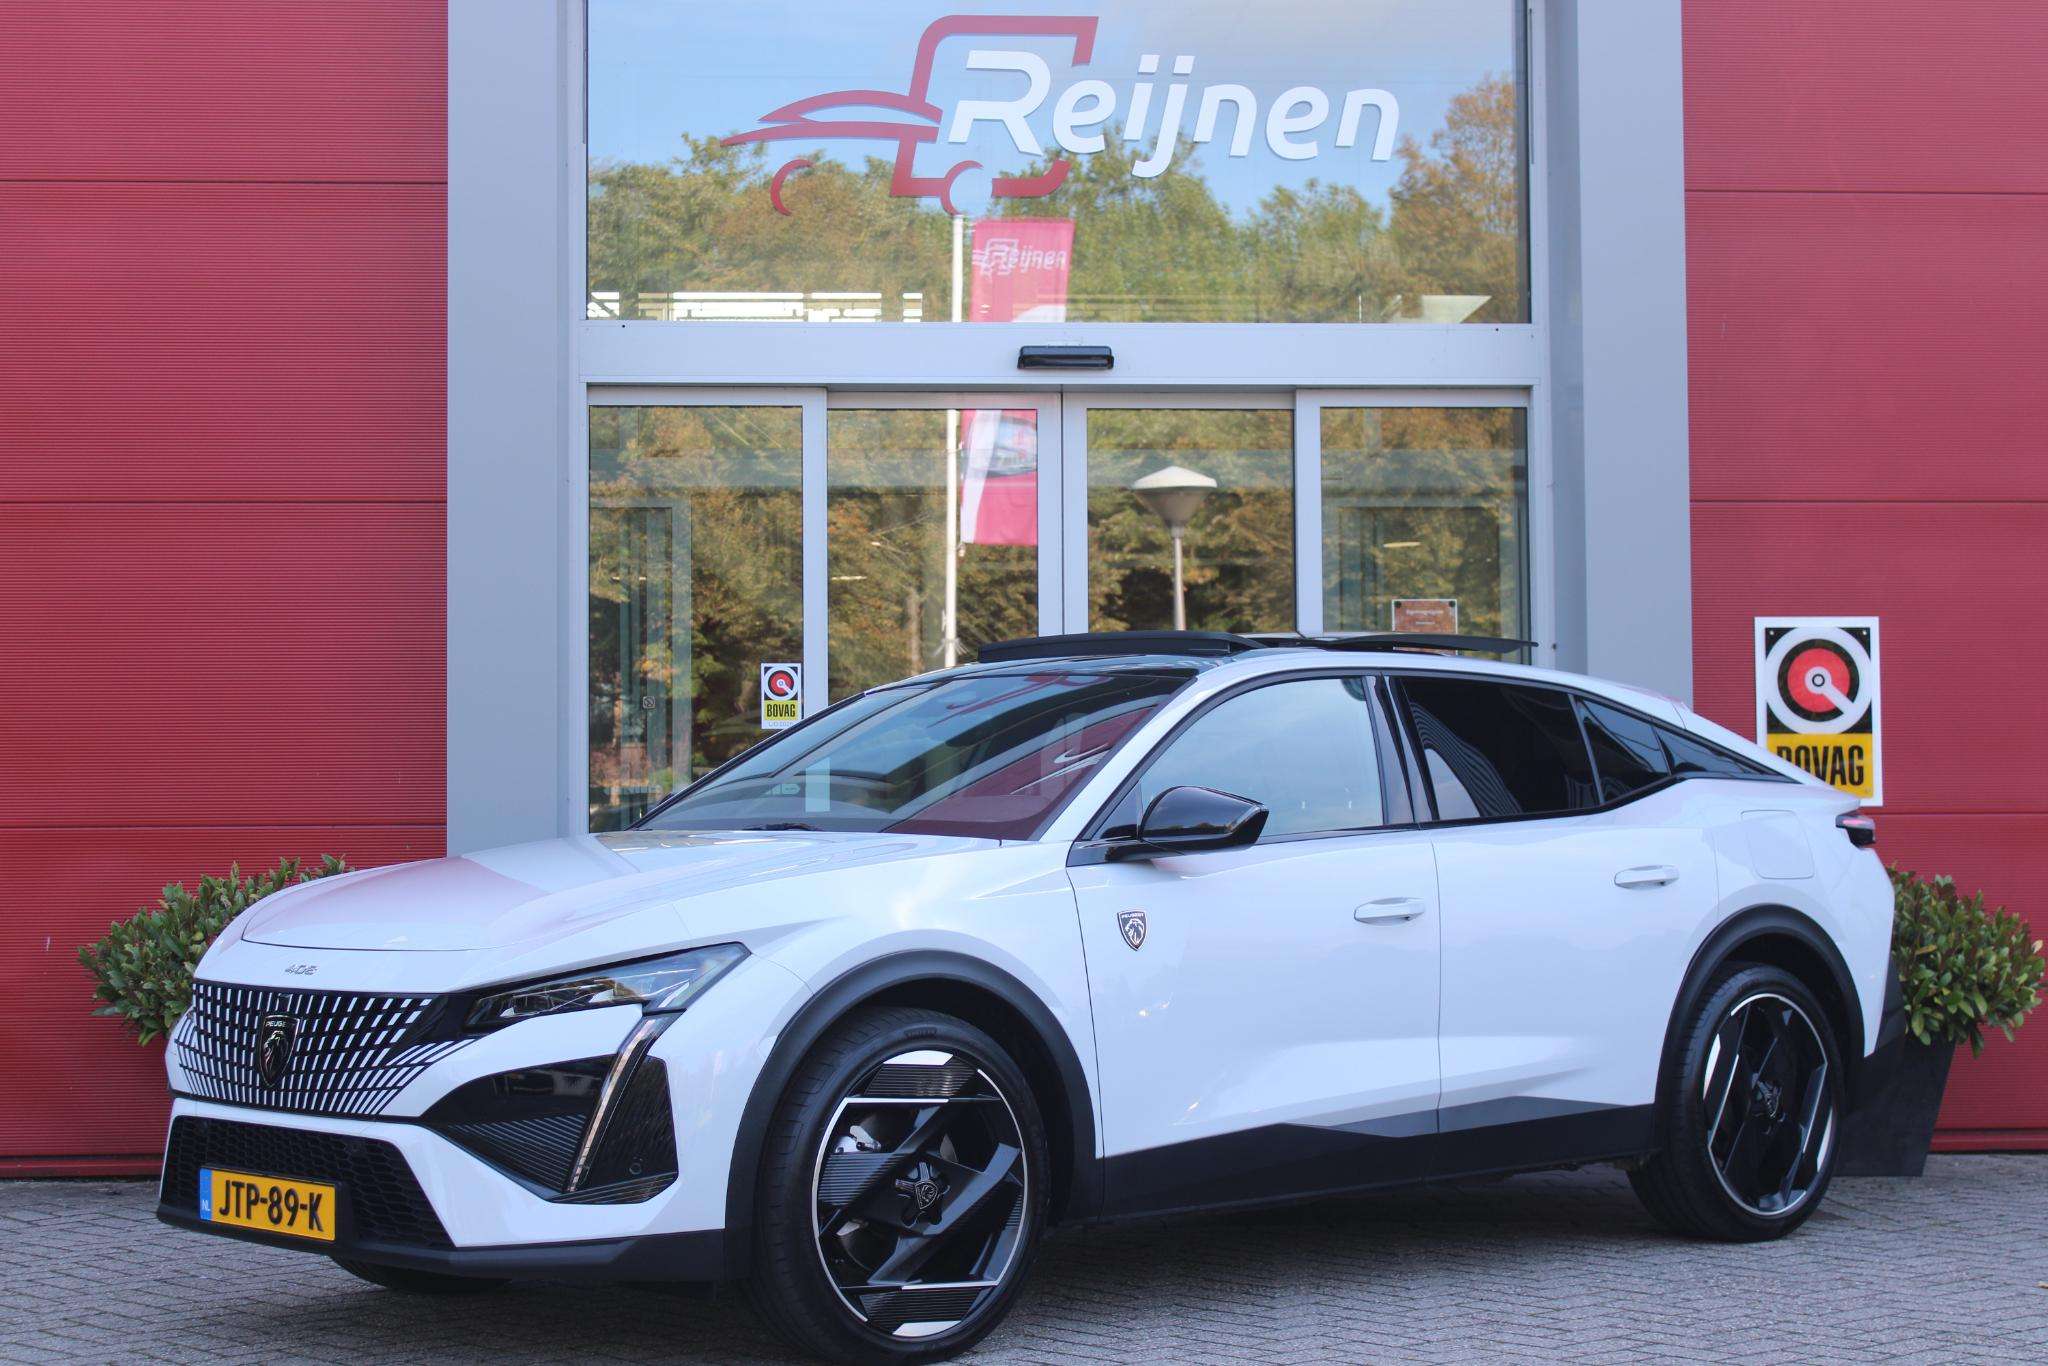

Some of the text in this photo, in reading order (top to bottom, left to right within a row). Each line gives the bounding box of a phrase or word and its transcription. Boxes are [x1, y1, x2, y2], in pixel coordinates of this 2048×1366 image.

[947, 50, 1400, 178] Reijnen
[766, 704, 796, 718] BOVAG
[202, 1180, 324, 1232] NL JTP-89-K
